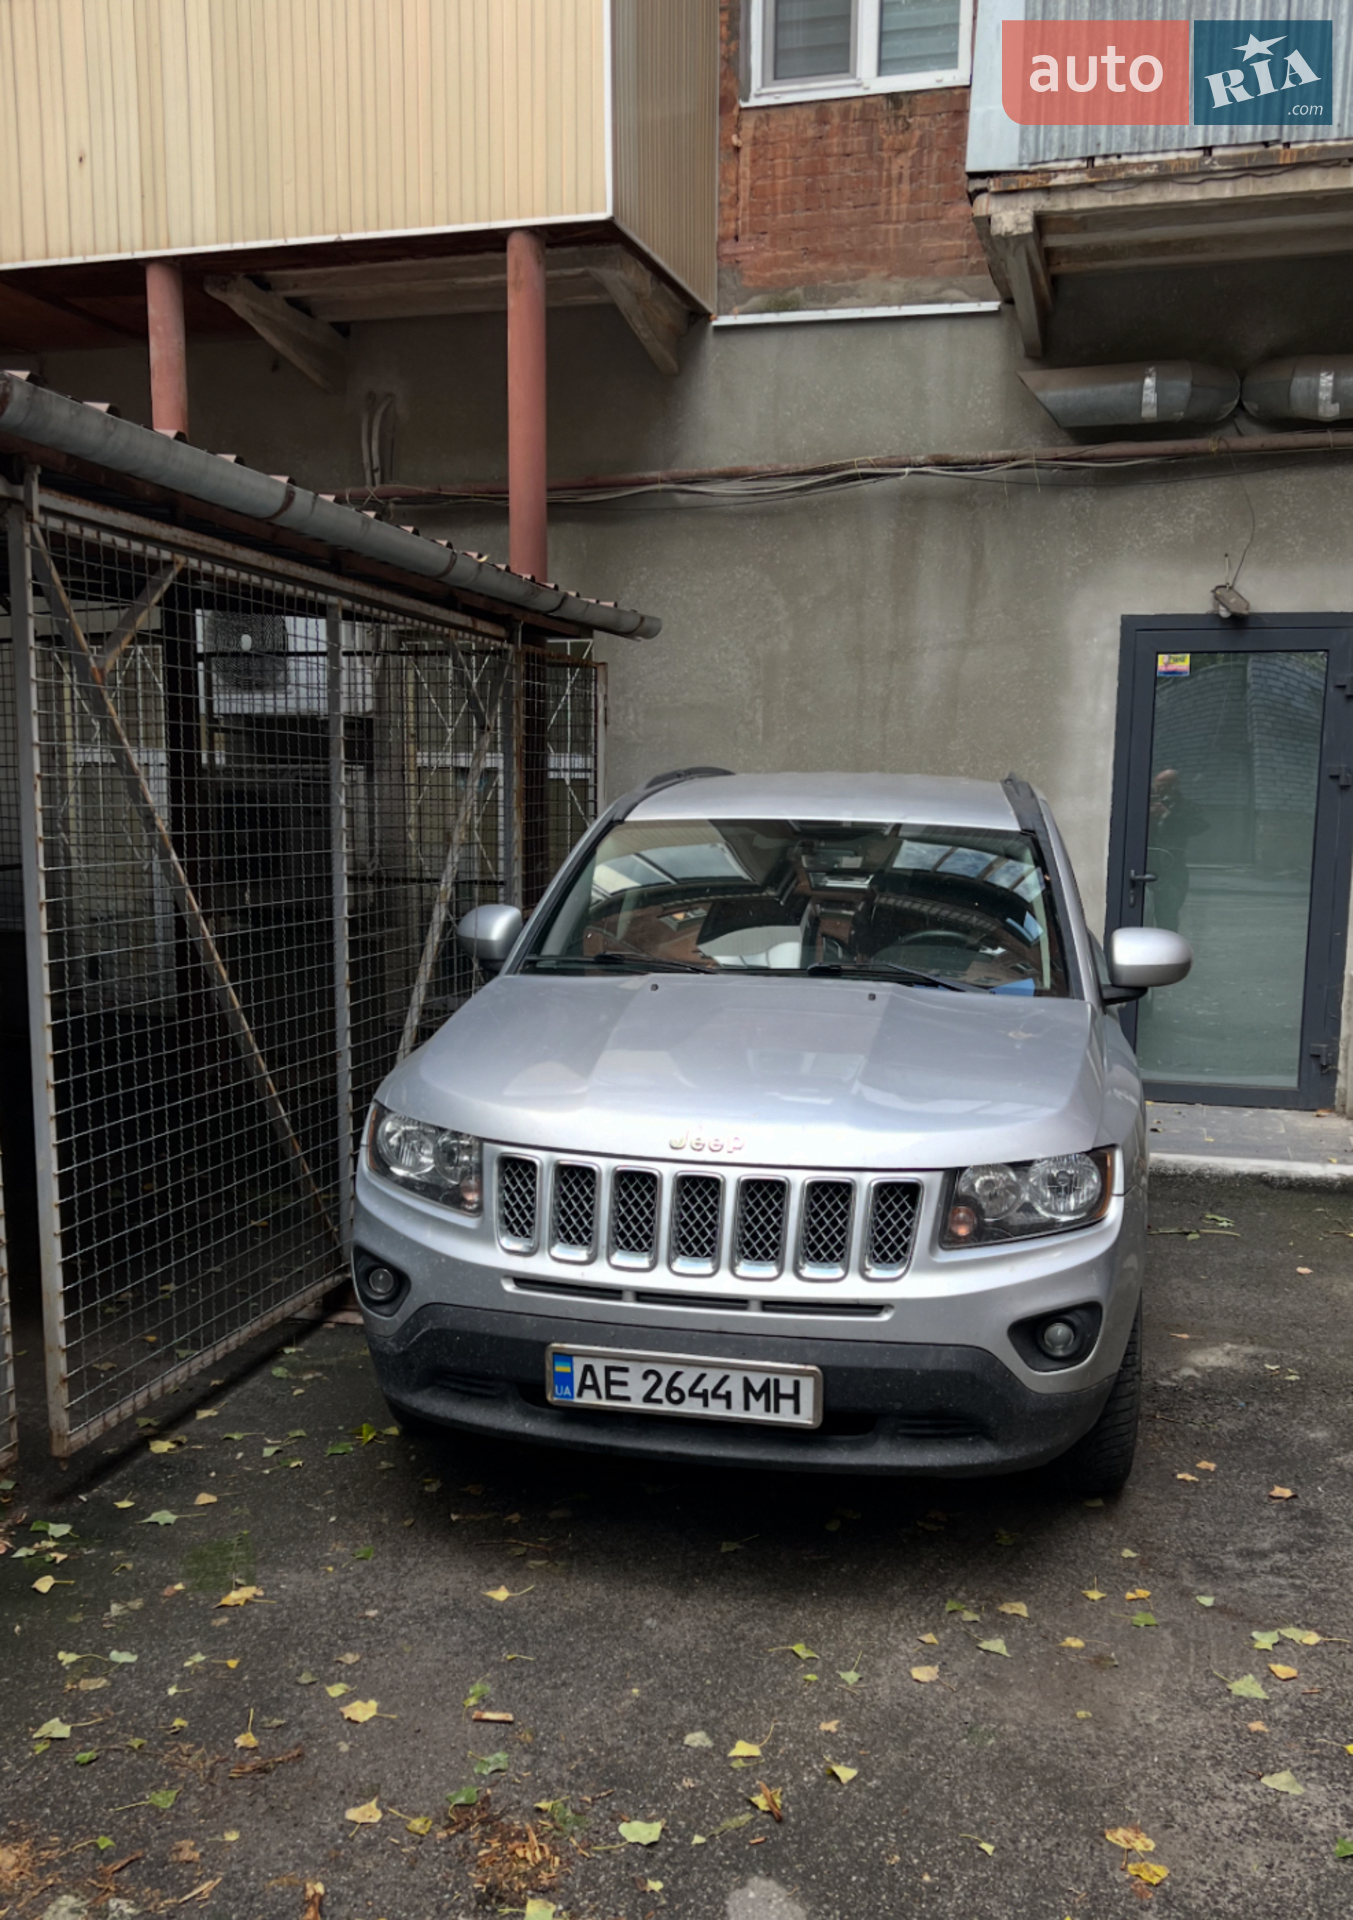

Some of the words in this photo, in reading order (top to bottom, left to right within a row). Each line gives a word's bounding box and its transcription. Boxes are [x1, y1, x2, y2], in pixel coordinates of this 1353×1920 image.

[669, 1130, 746, 1154] Jeep
[555, 1385, 572, 1398] UA
[576, 1364, 632, 1402] AE
[641, 1369, 732, 1410] 2644
[743, 1376, 801, 1415] MH
